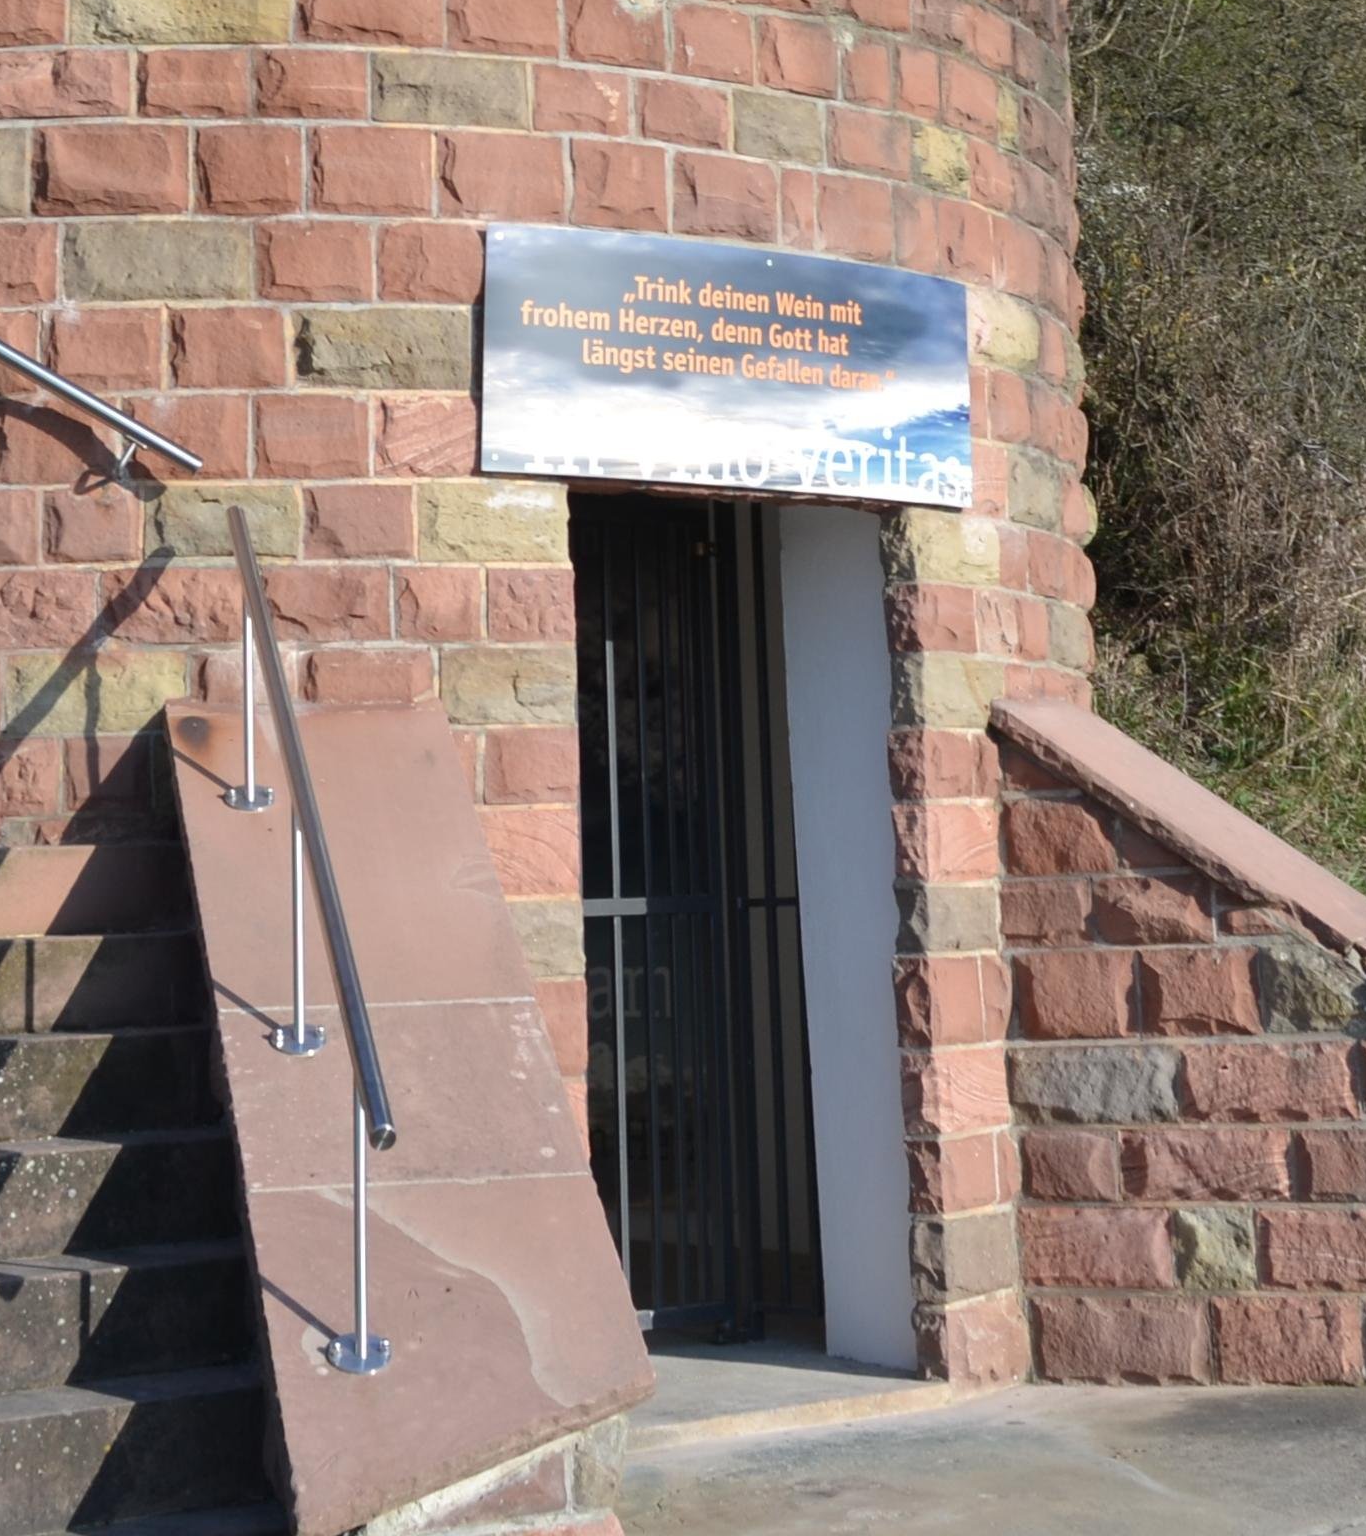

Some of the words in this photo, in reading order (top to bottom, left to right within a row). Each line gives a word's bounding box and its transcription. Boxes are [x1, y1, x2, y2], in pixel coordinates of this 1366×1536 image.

[698, 282, 770, 313] deinen
[776, 291, 824, 320] Wein
[830, 300, 863, 325] mit
[520, 300, 611, 331] frohem
[618, 308, 704, 343] Herzen,
[711, 317, 763, 346] denn
[769, 324, 813, 352] Gott
[818, 329, 850, 356] hat
[582, 338, 657, 374] längst
[662, 347, 734, 376] seinen
[741, 354, 824, 385] Gefallen
